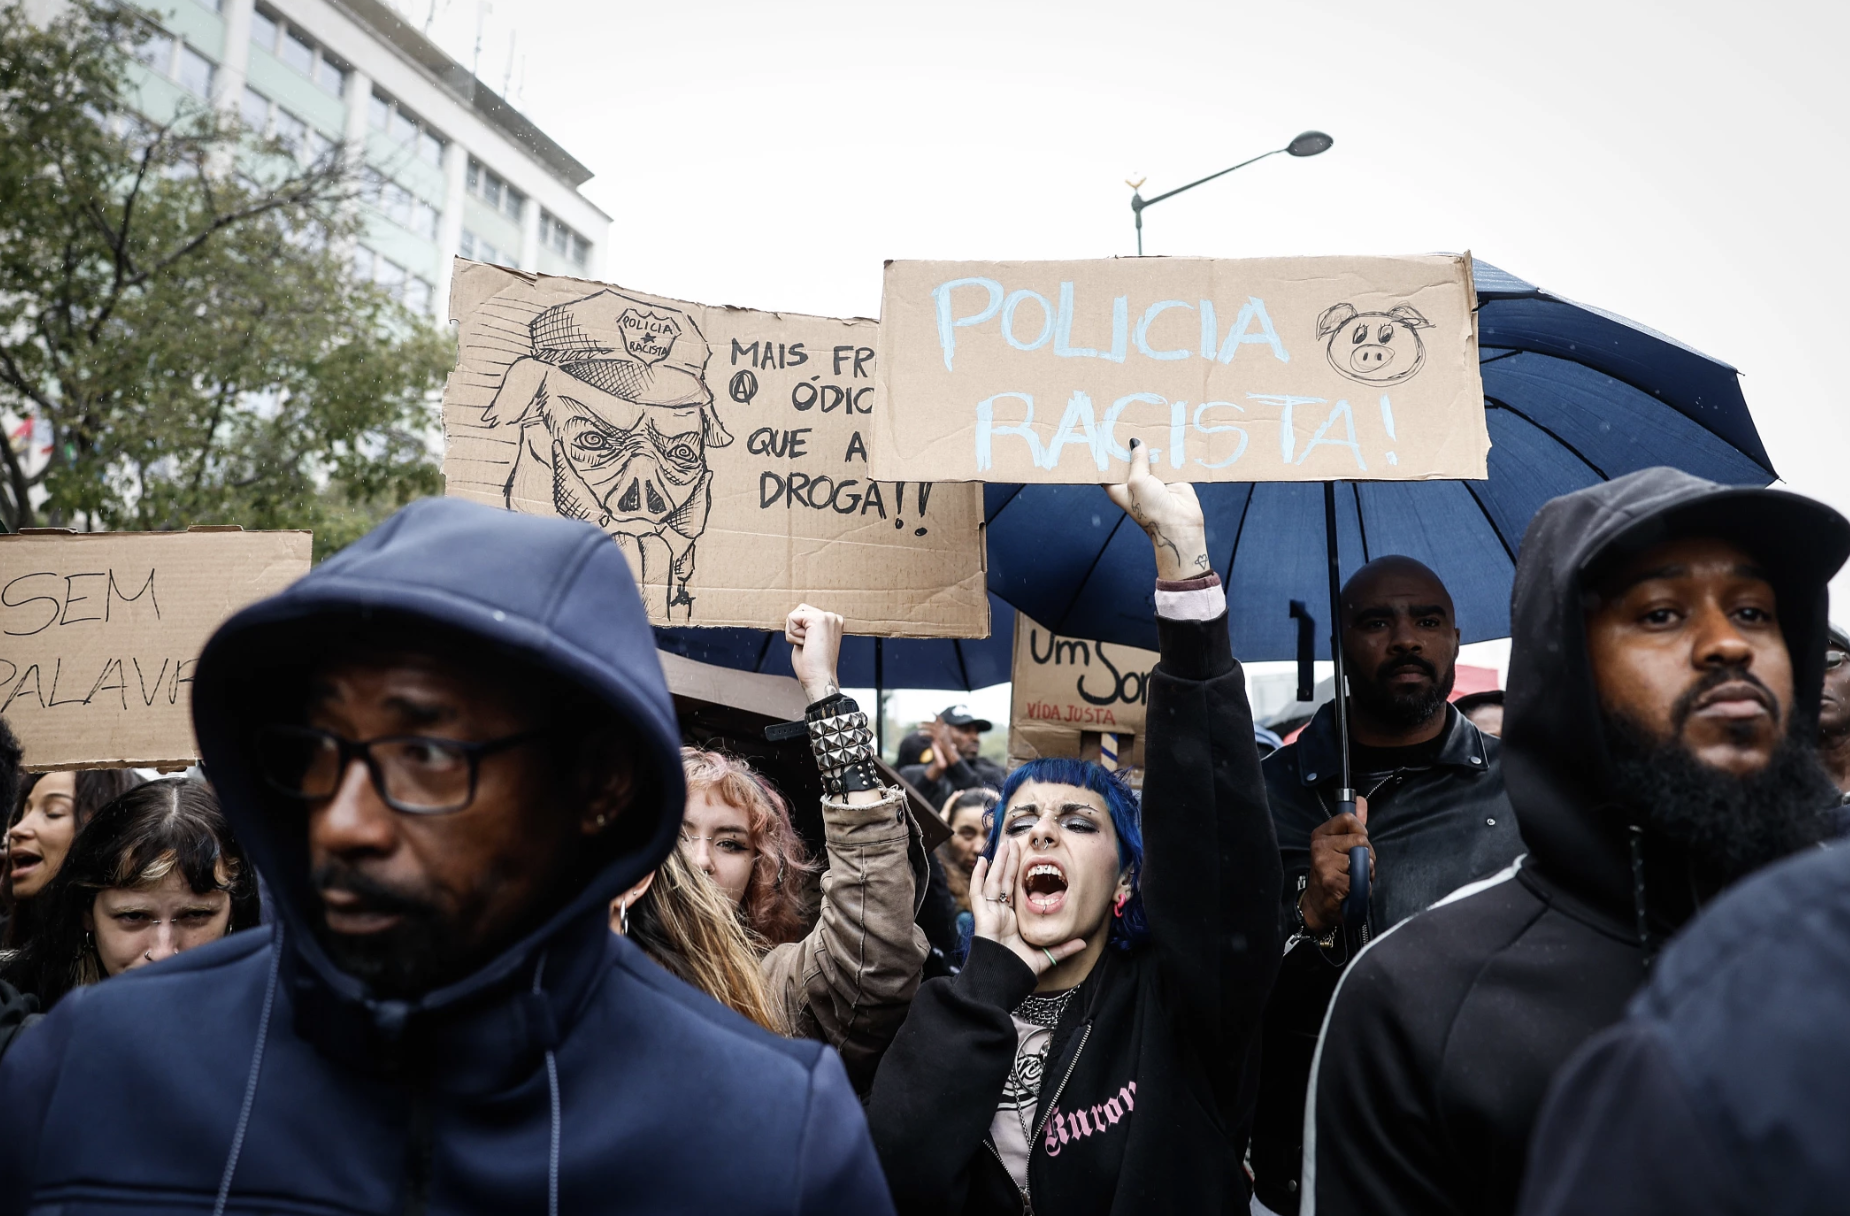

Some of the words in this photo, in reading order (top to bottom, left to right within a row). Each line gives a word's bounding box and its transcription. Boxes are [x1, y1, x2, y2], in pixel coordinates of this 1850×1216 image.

[622, 315, 673, 335] POLICIA
[931, 276, 1290, 373] POLICIA
[629, 341, 669, 357] RACISTA
[730, 337, 809, 370] MAIS
[833, 345, 877, 378] FR
[747, 427, 812, 459] QUE
[845, 431, 868, 463] A
[974, 390, 1398, 472] RACISTA!
[1, 567, 161, 636] SEM
[1030, 629, 1090, 667] Um
[1064, 704, 1117, 726] JUSTA
